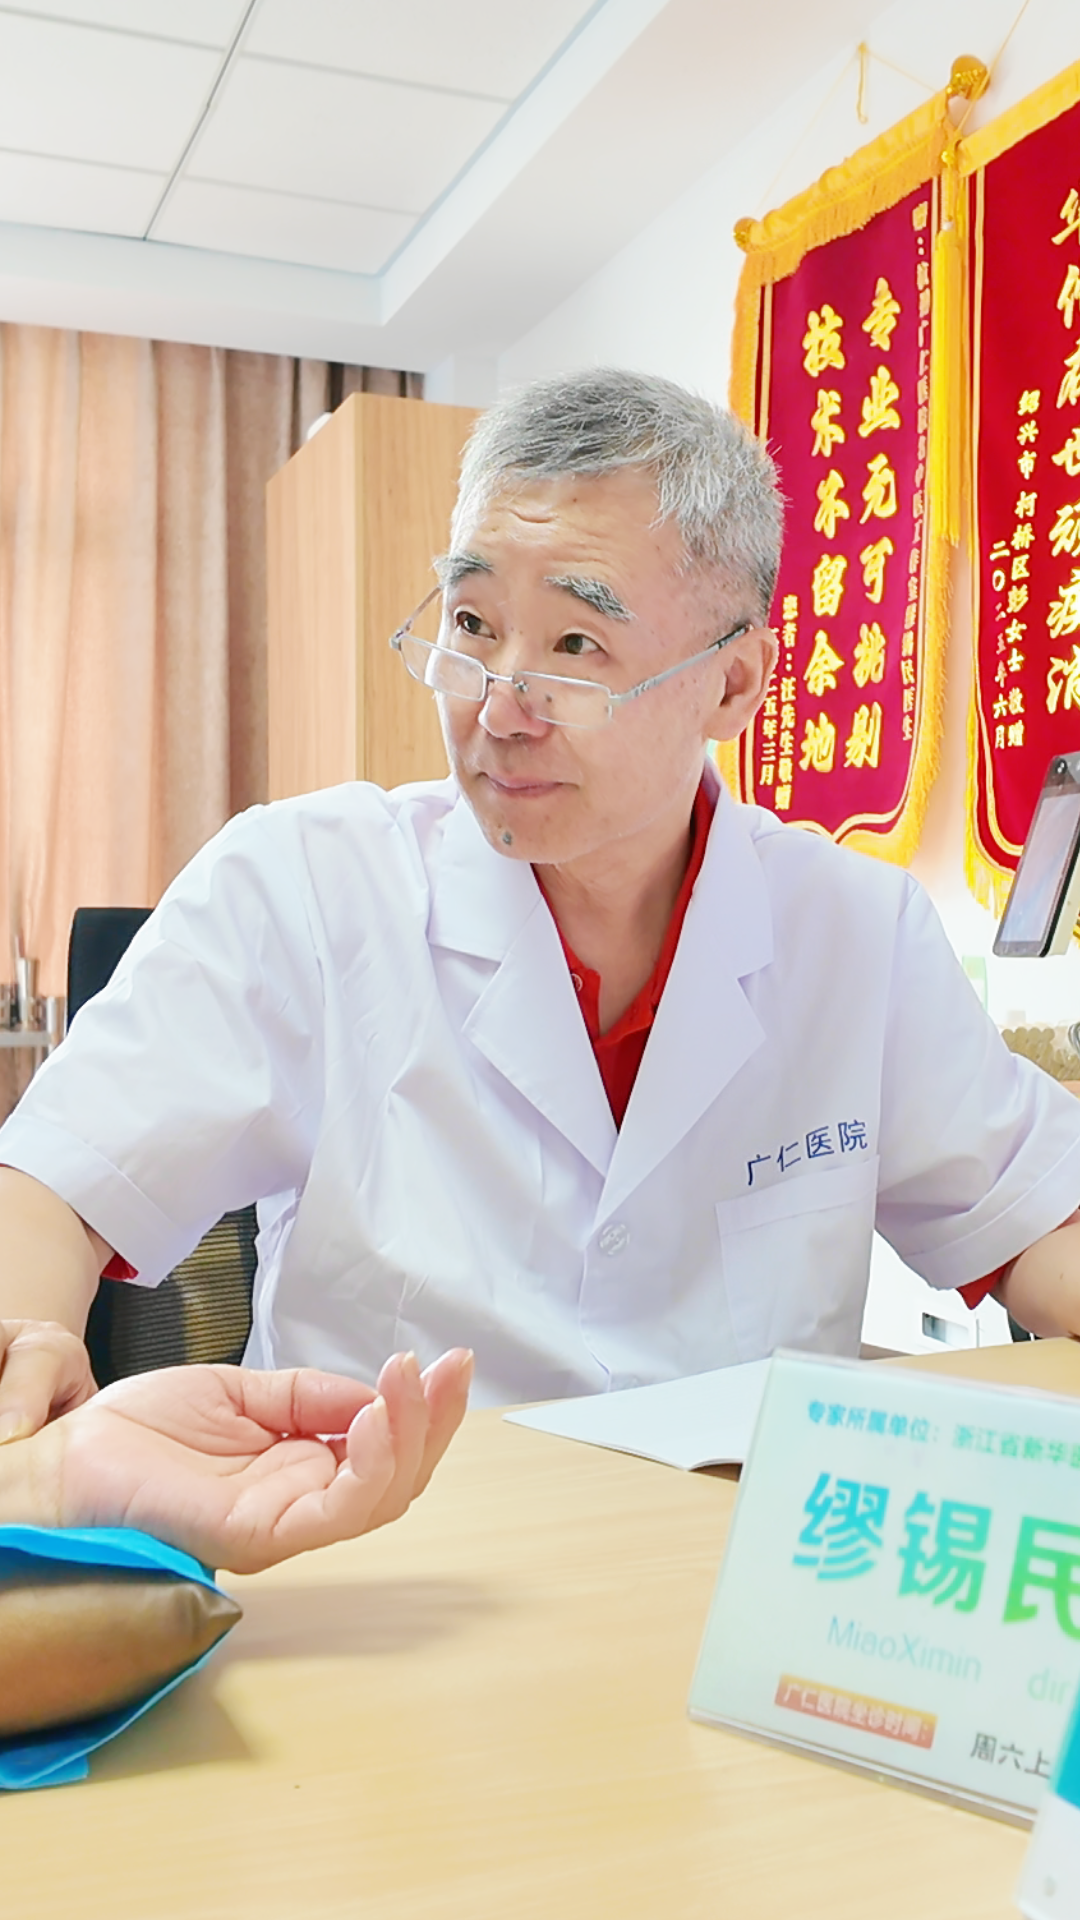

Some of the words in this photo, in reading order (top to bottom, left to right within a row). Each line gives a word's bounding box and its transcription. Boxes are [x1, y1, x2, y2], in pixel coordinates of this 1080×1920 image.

[799, 304, 850, 773] 技术不留余地
[844, 277, 901, 769] 专业无可挑剔
[746, 1119, 869, 1186] 广仁医院
[792, 1472, 1080, 1642] 缪锡民
[827, 1615, 983, 1682] MiaoXimin
